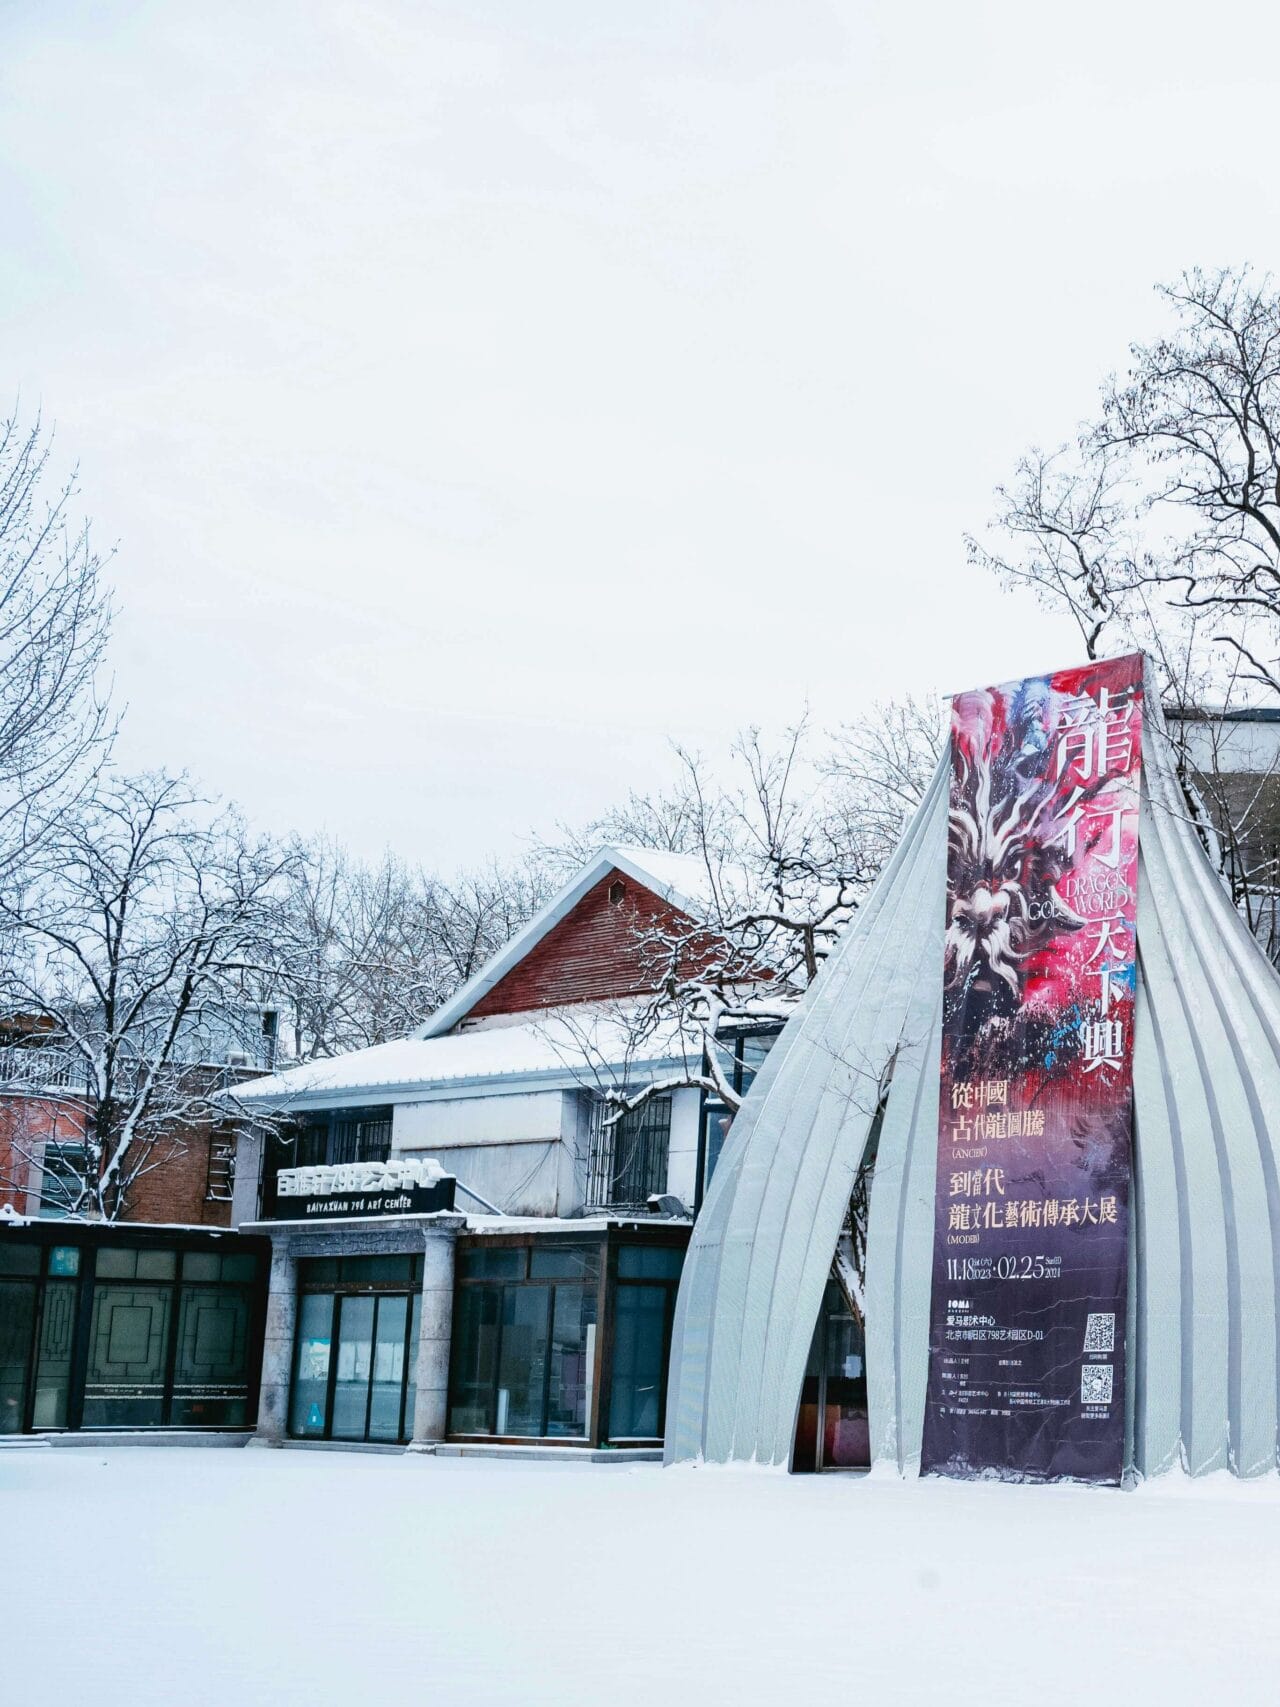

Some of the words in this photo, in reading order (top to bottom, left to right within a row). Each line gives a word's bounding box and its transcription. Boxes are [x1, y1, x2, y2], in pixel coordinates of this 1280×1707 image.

[951, 1080, 1008, 1109] 從中國
[950, 1109, 1045, 1142] 古代龍圖騰
[949, 1168, 1005, 1197] 到當代
[948, 1195, 1118, 1231] 龍文化藝術傳承大展
